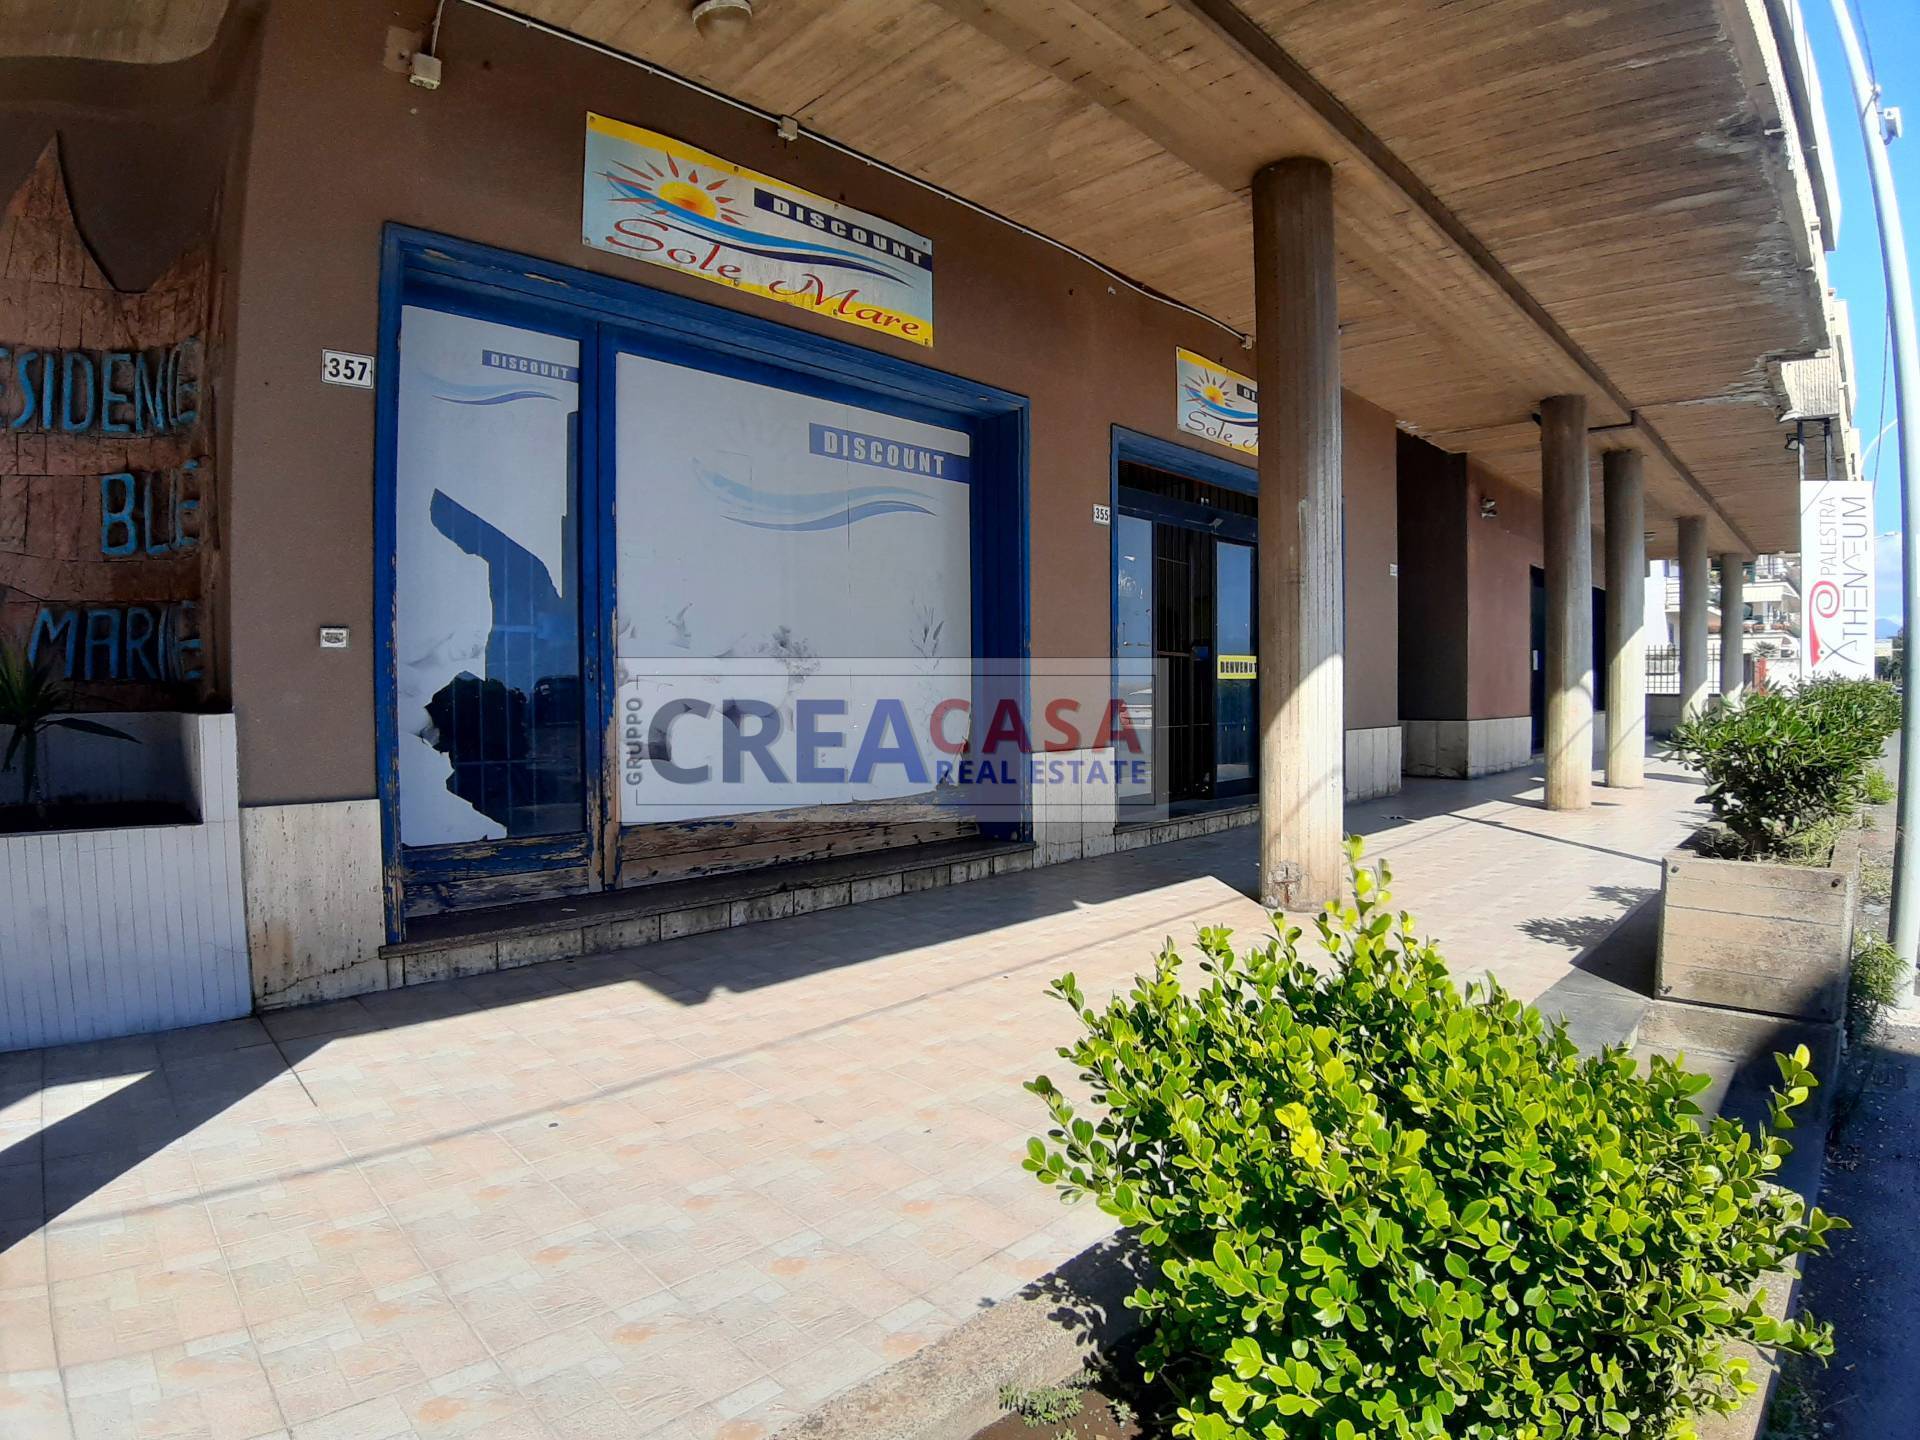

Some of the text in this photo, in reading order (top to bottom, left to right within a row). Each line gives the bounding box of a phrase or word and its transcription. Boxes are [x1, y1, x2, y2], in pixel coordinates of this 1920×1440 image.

[772, 197, 924, 265] DISCOUNT
[605, 218, 919, 336] Sole Mare
[328, 357, 368, 381] 357
[490, 353, 569, 379] DISCOUNT
[1185, 411, 1233, 443] Sole
[823, 430, 945, 475] DISCOUNT
[1095, 507, 1109, 521] 355
[1819, 496, 1838, 576] PALESTRA
